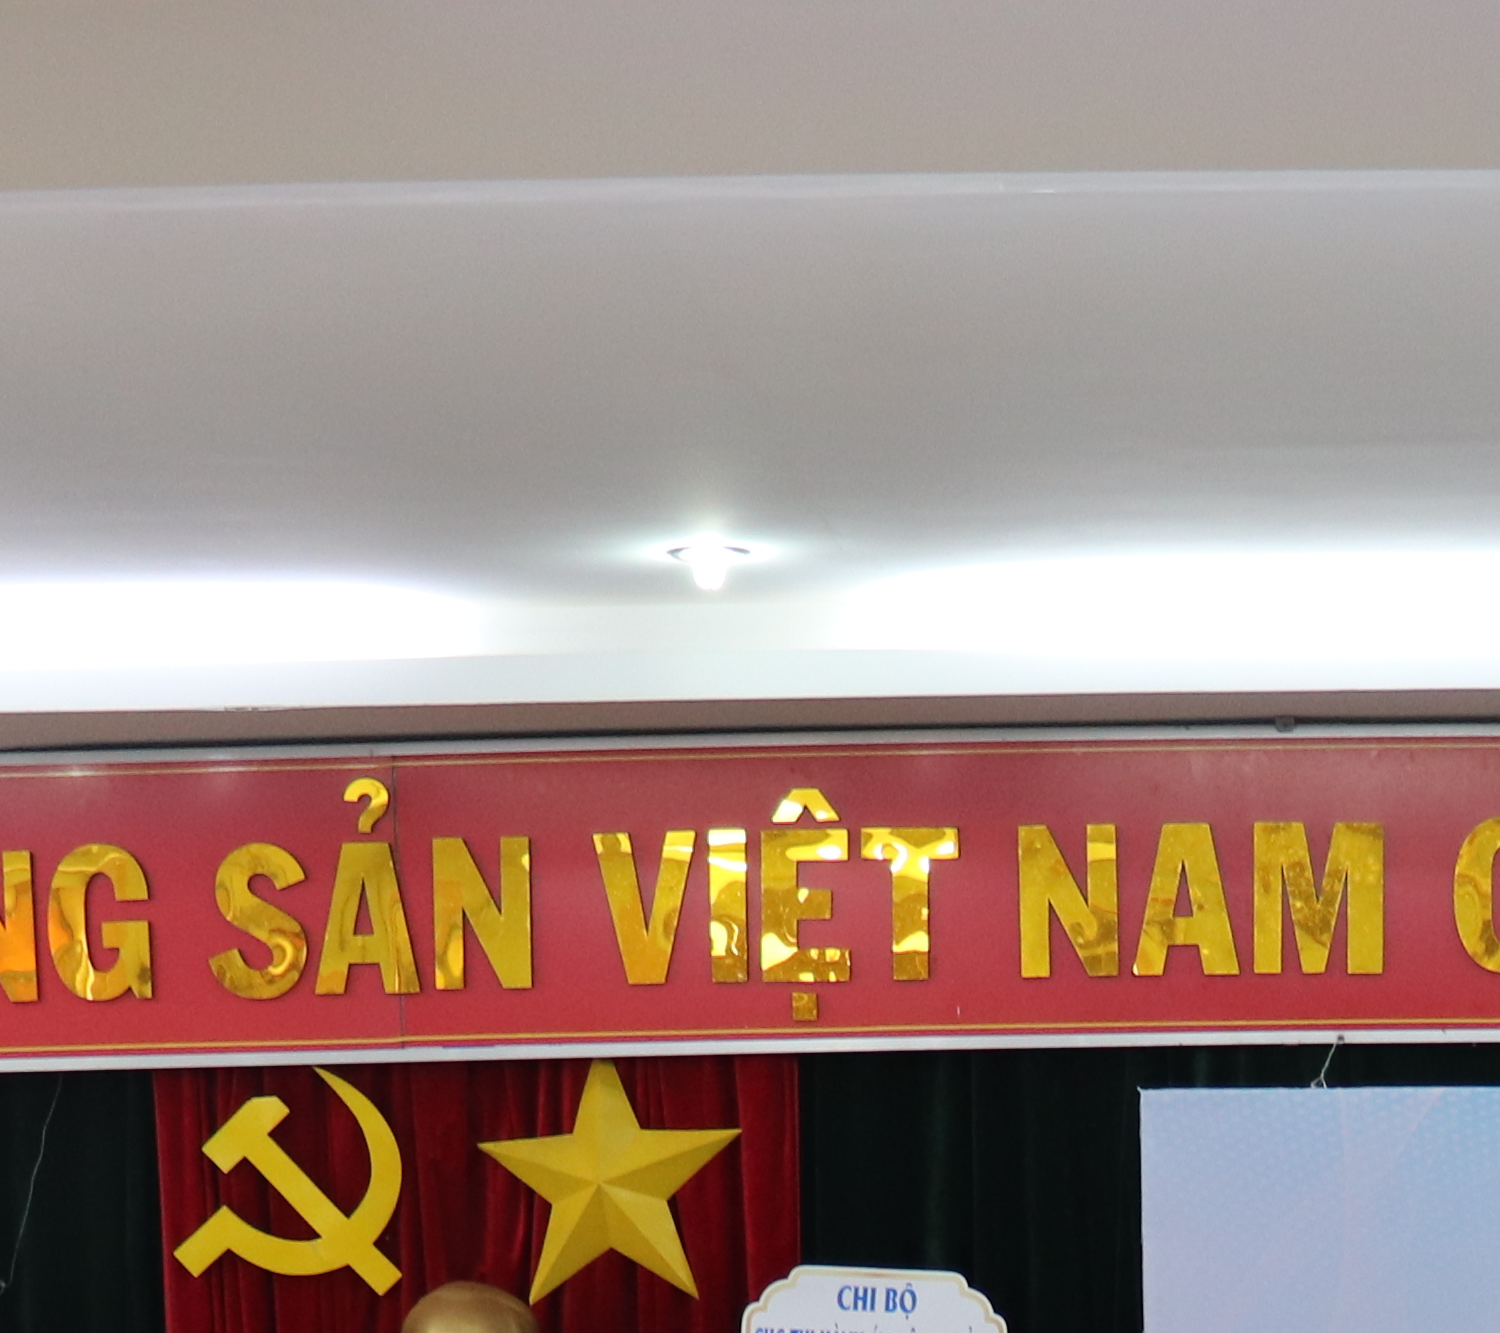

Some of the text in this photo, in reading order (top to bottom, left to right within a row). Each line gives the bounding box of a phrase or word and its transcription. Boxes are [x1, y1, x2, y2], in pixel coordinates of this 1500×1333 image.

[209, 777, 534, 1000] SẢN
[592, 787, 961, 1022] VIỆT
[1018, 820, 1387, 979] NAM
[836, 1282, 918, 1319] CHI BỘ
